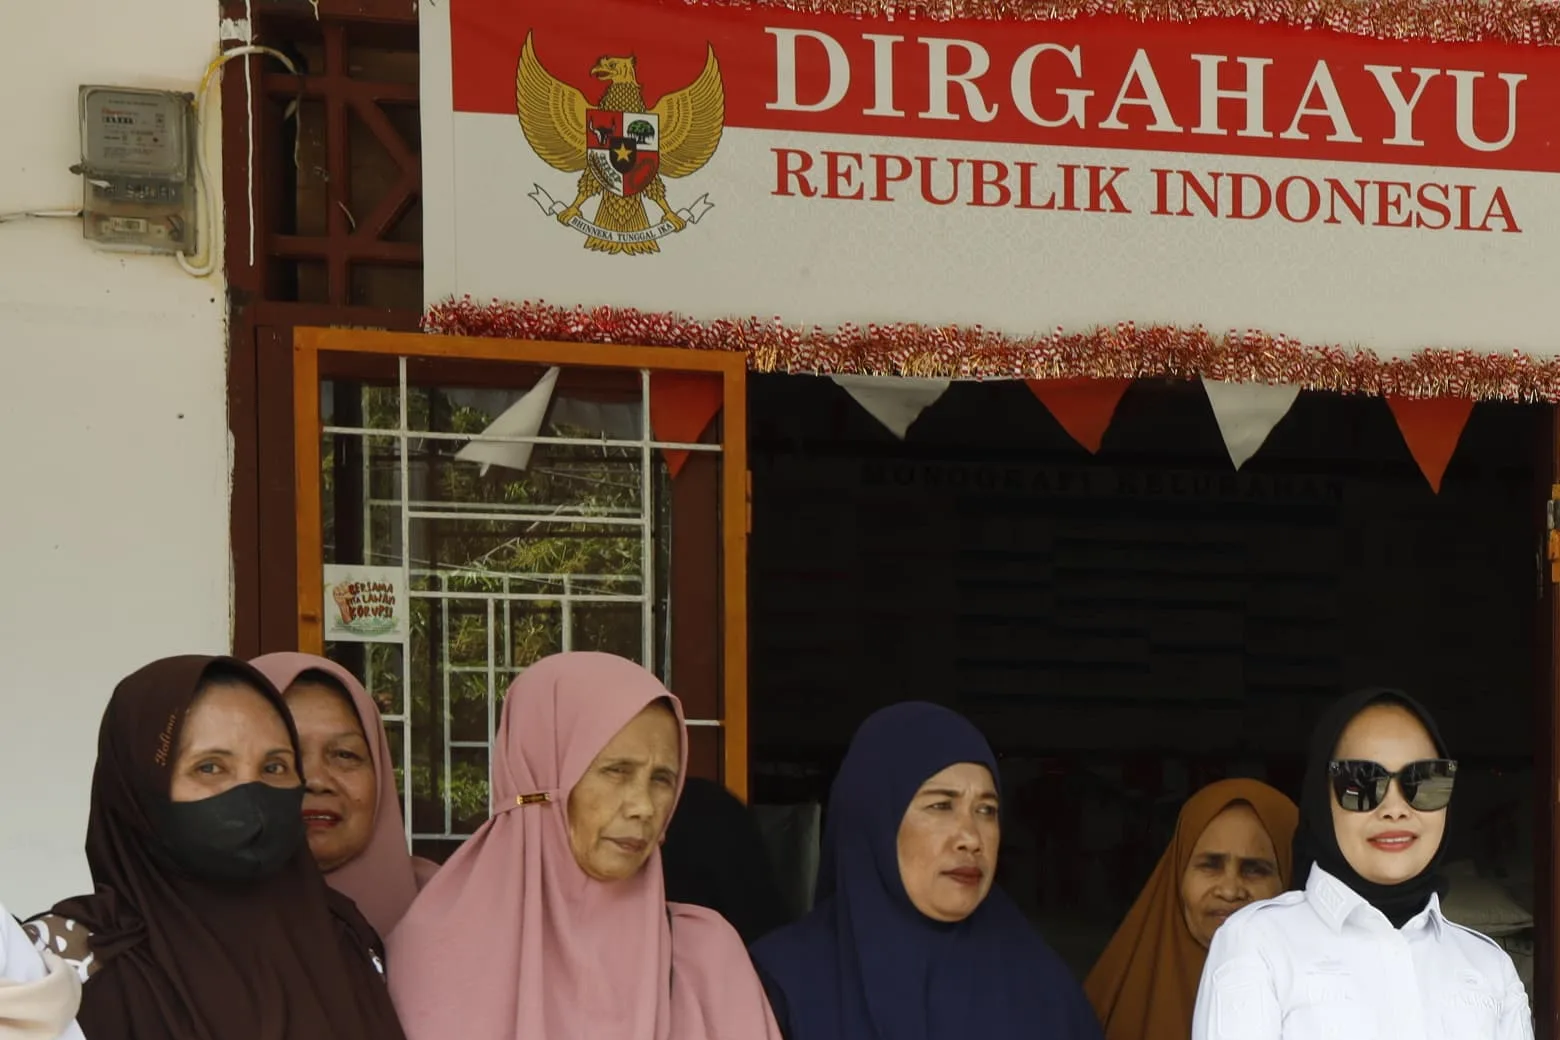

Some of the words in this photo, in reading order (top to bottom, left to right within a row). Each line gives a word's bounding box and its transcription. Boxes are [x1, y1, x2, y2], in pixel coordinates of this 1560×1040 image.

[765, 27, 1527, 152] DIRGAHAYU
[771, 147, 1131, 214] REPUBLIK
[1152, 169, 1522, 233] INDONESIA
[571, 217, 613, 241] BHINNEKA
[617, 232, 657, 242] TUNGGAL
[658, 223, 673, 235] IKA
[860, 462, 1092, 492] MONOGRAFI
[1116, 469, 1346, 504] KELURAHAN
